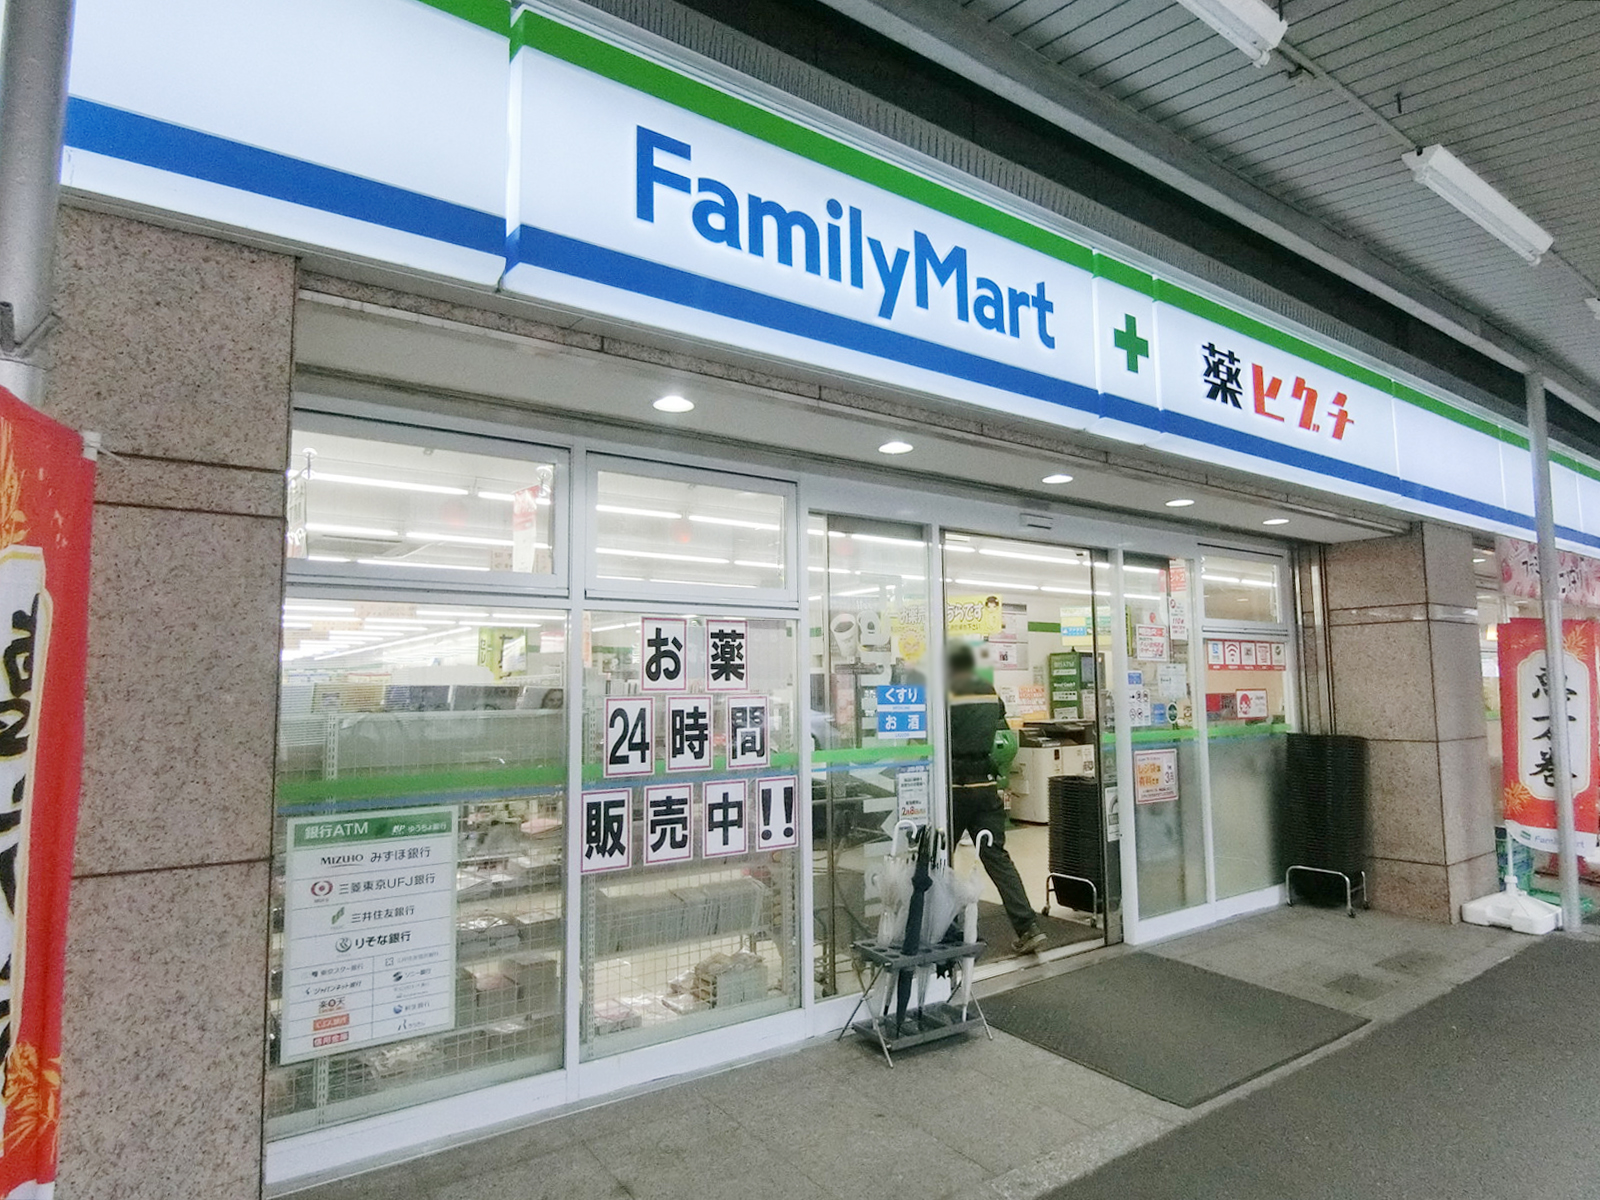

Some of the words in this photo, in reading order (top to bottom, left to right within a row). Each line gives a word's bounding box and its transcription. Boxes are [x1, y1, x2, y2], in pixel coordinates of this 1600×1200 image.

[636, 125, 1055, 350] FamilyMart
[885, 687, 918, 703] くすり
[885, 714, 920, 730] お酒
[304, 821, 369, 840] 銀行ATM
[320, 853, 364, 866] MIZUHO
[370, 846, 432, 863] みずほ銀行
[339, 873, 436, 895] 三菱東京UFJ銀行
[351, 905, 416, 924] 三井住友銀行
[354, 930, 412, 949] りそな銀行
